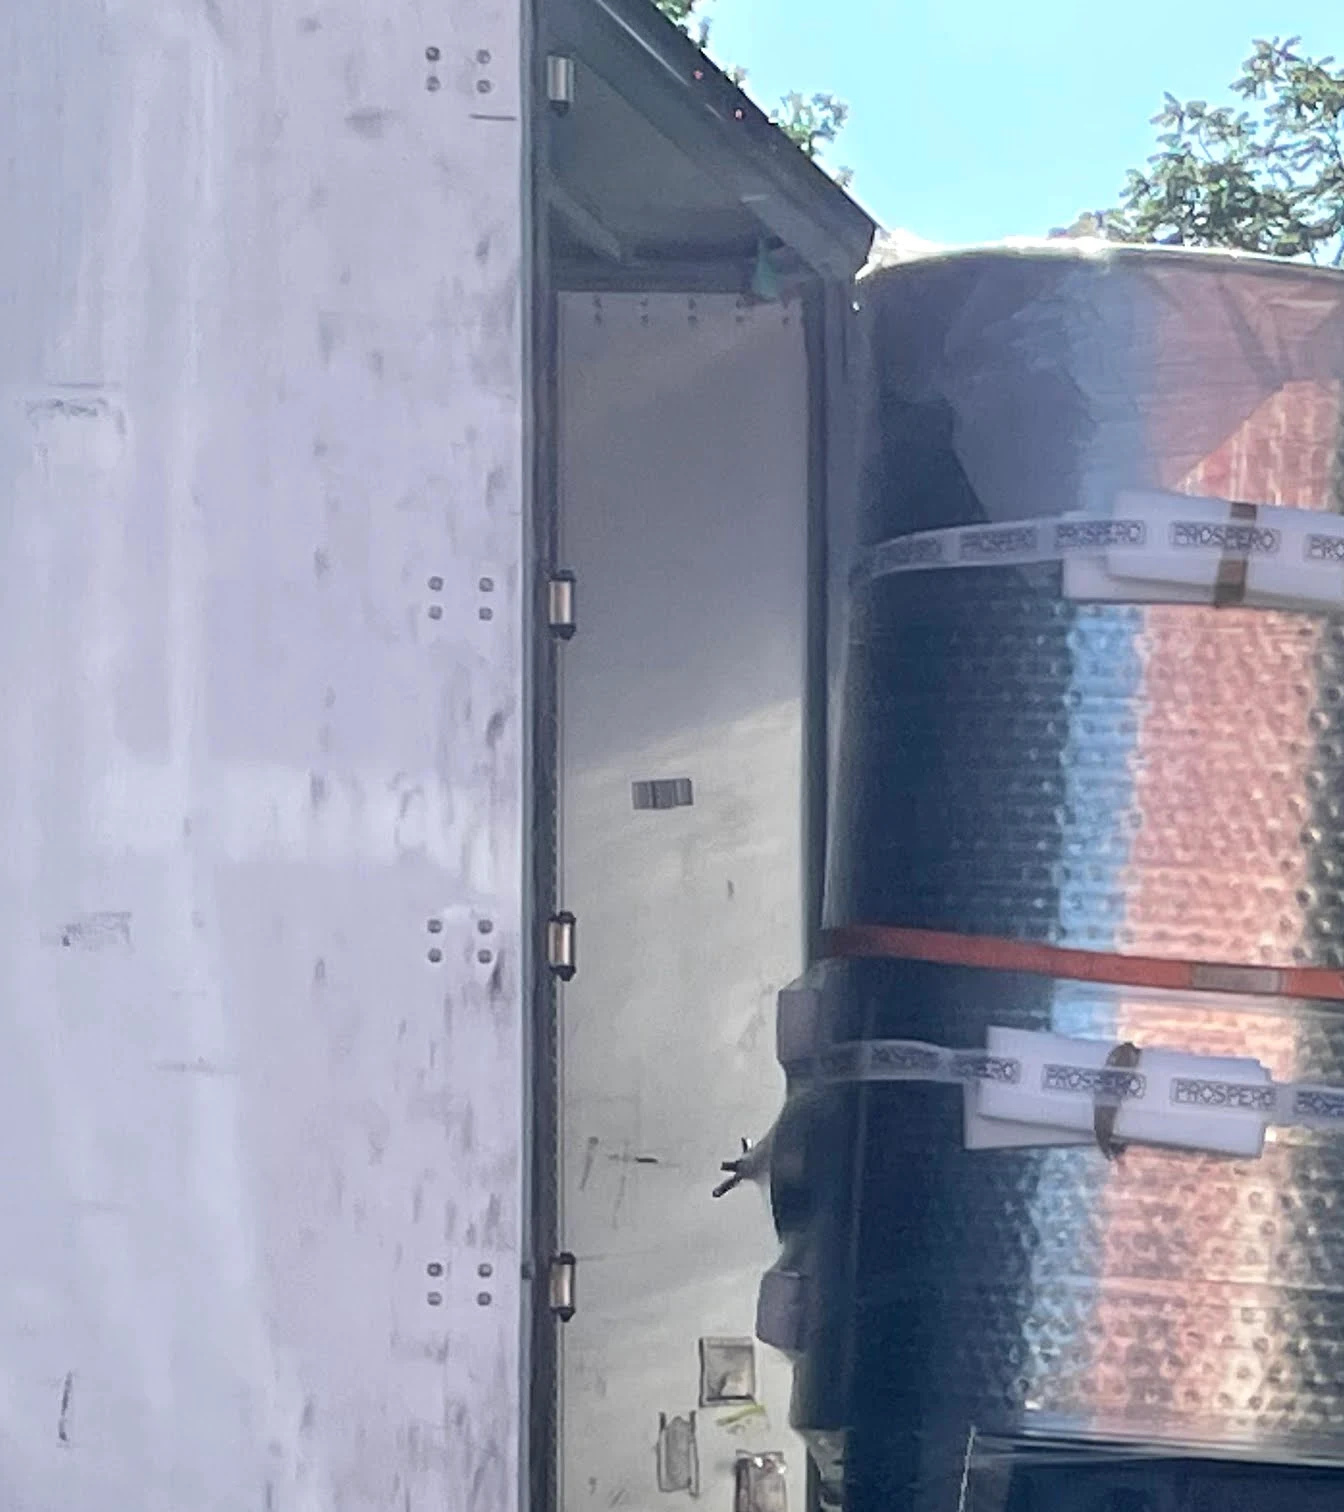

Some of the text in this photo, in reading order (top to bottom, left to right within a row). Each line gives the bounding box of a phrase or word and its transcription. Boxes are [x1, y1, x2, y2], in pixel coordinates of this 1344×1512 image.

[1174, 523, 1275, 550] PROSPERO
[1046, 1065, 1142, 1098] PROSPERO
[1176, 1078, 1278, 1110] PROSPERO
